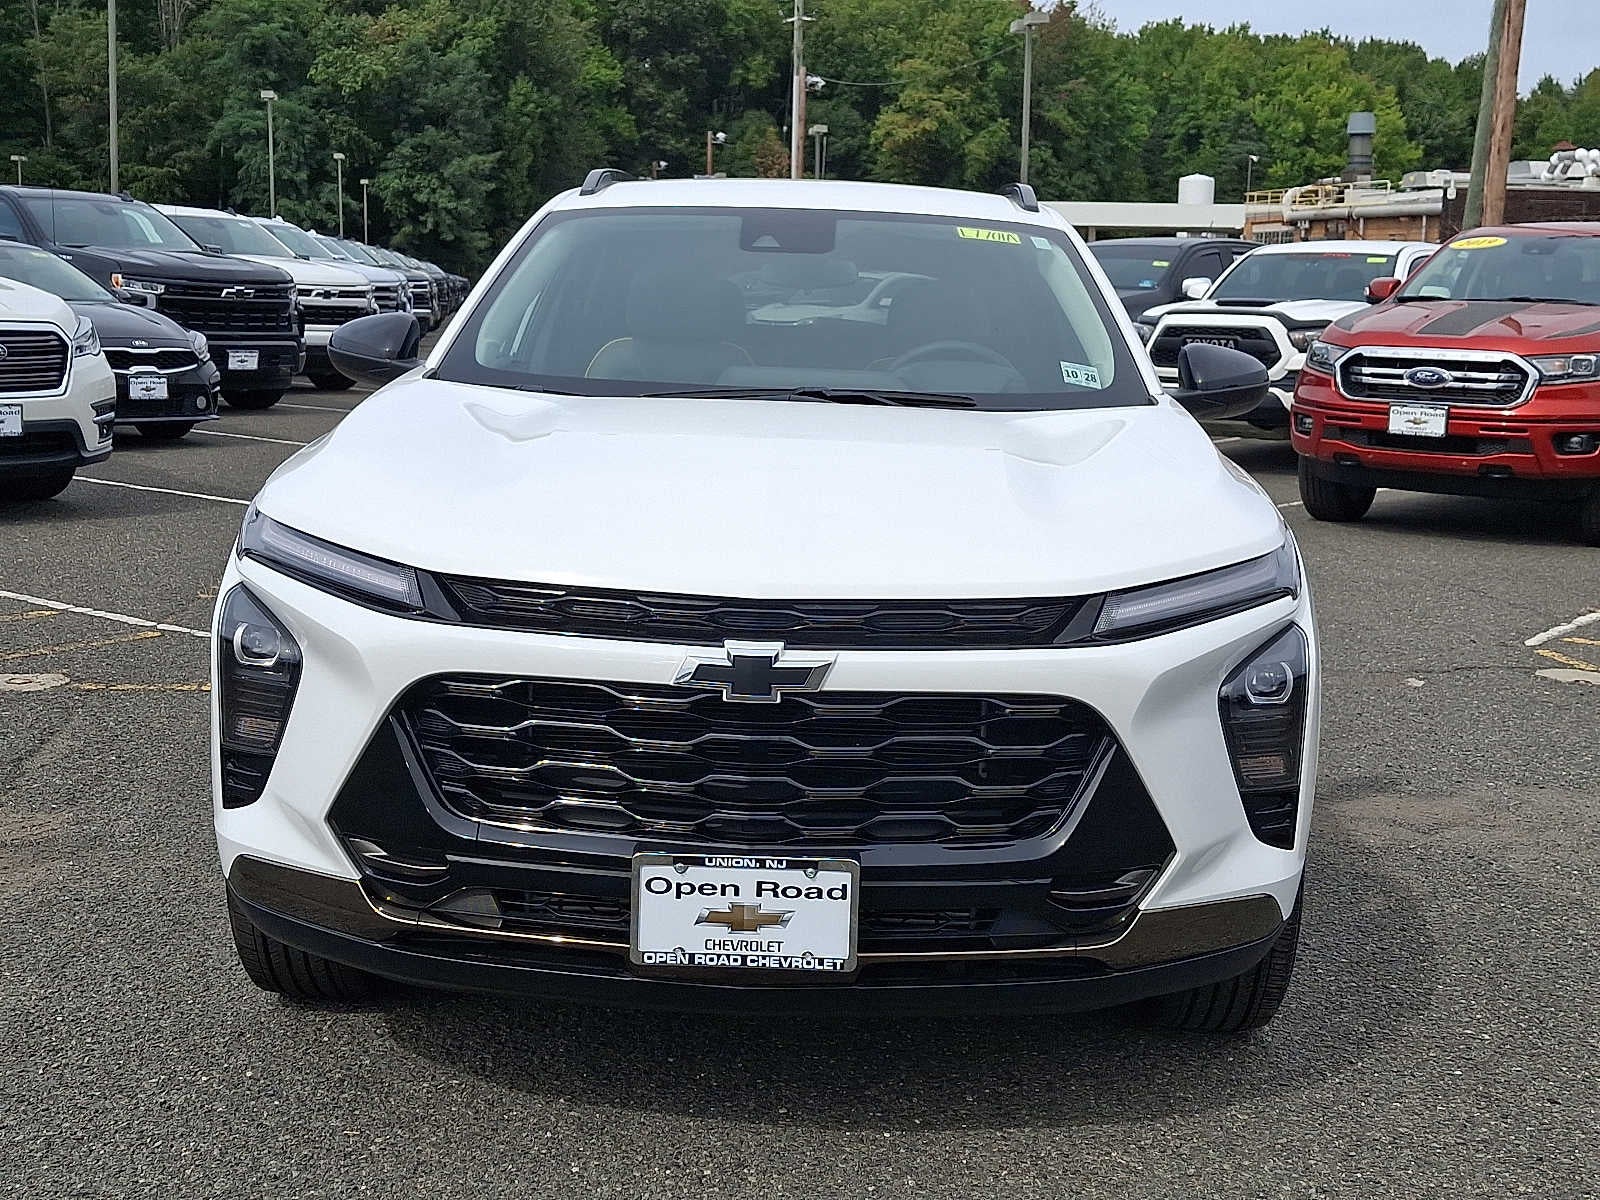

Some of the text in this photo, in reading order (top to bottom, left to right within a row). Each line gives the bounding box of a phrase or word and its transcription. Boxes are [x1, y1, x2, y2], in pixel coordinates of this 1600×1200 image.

[1064, 369, 1097, 383] 10 28
[765, 858, 787, 869] NJ
[644, 876, 848, 901] Open Road
[704, 938, 784, 953] CHEVROLET
[643, 952, 844, 970] OPEN ROAD CHEVROLET
